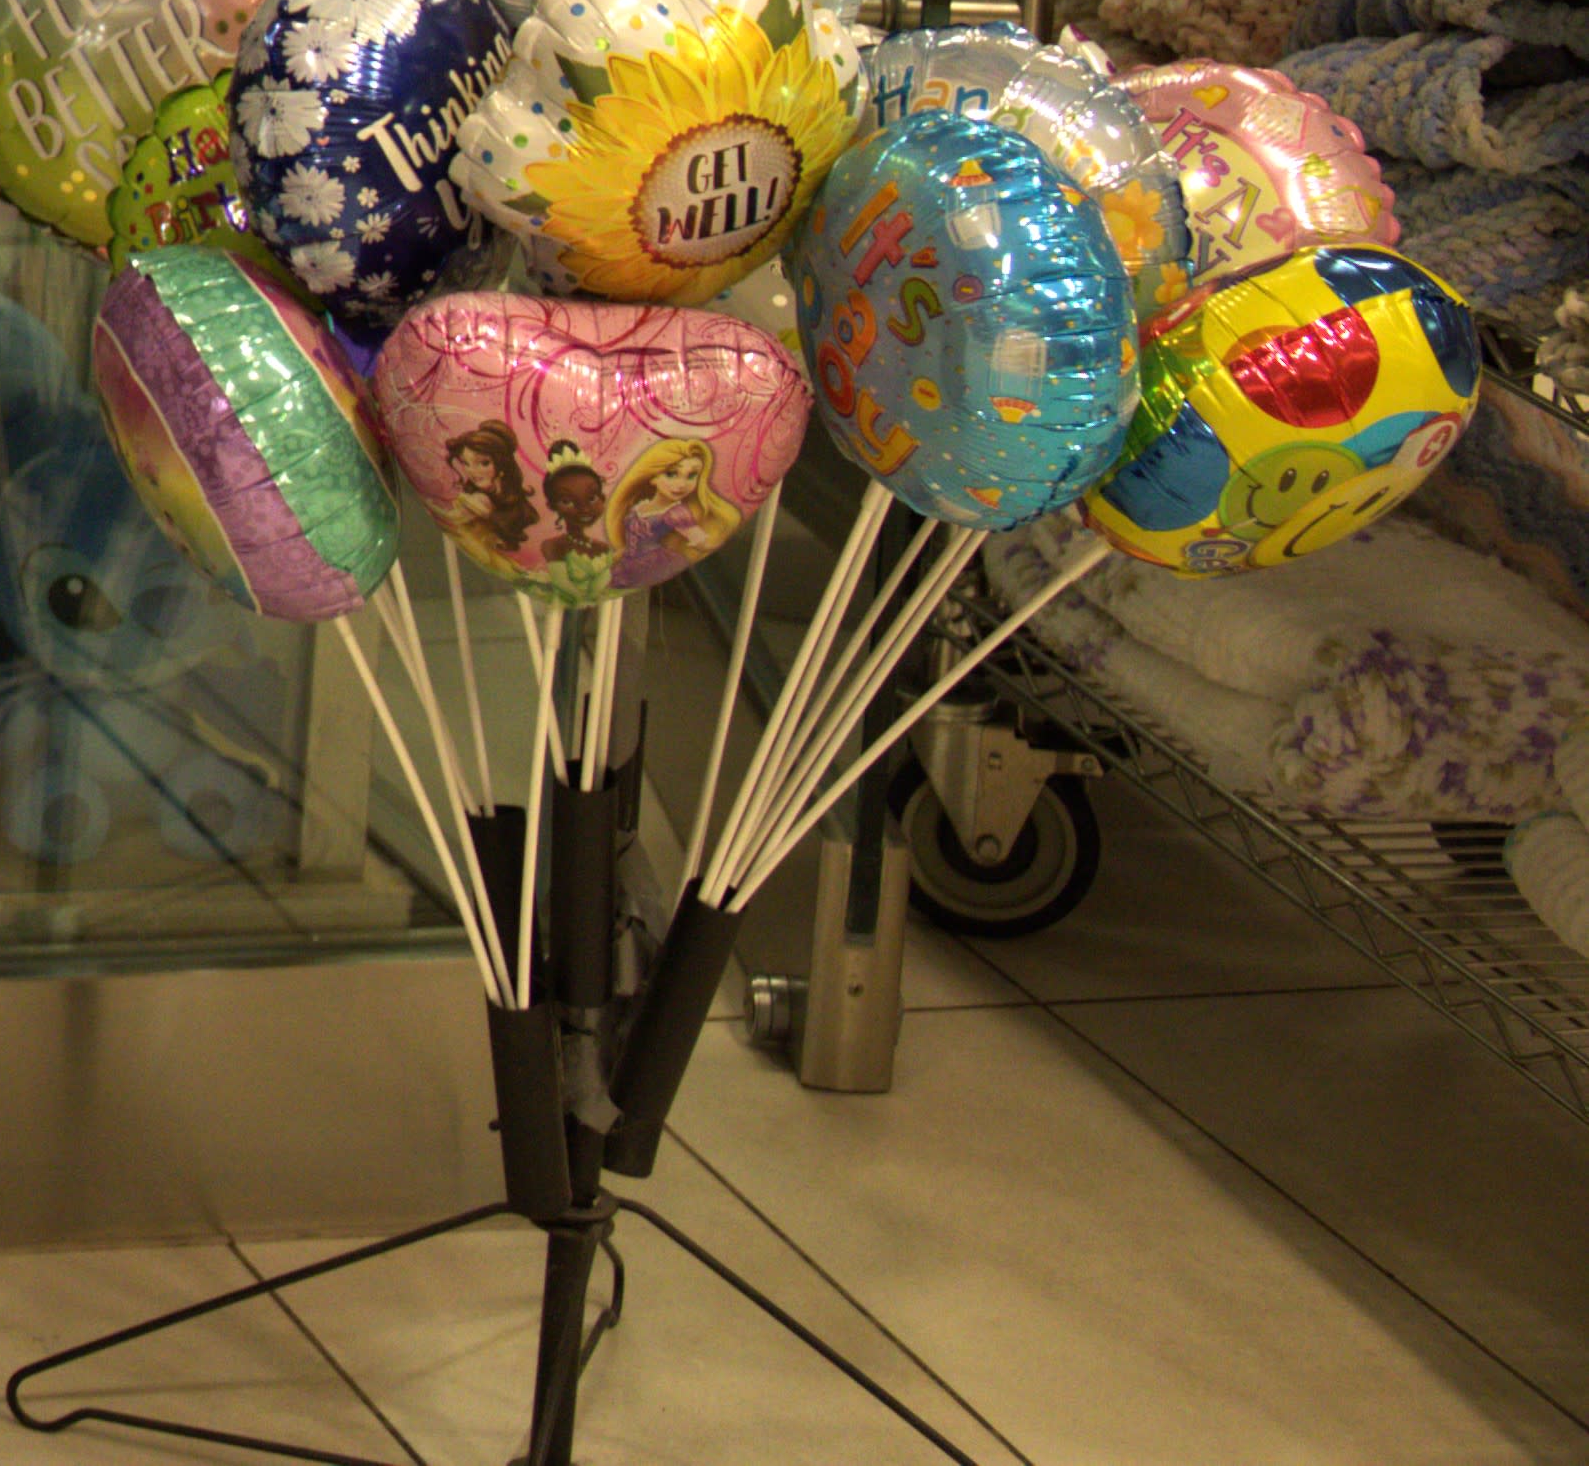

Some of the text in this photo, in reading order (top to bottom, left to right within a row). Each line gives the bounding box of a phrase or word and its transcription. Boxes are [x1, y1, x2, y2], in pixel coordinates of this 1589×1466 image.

[686, 140, 752, 197] GET
[656, 176, 781, 246] WELL!
[1193, 176, 1262, 251] A
